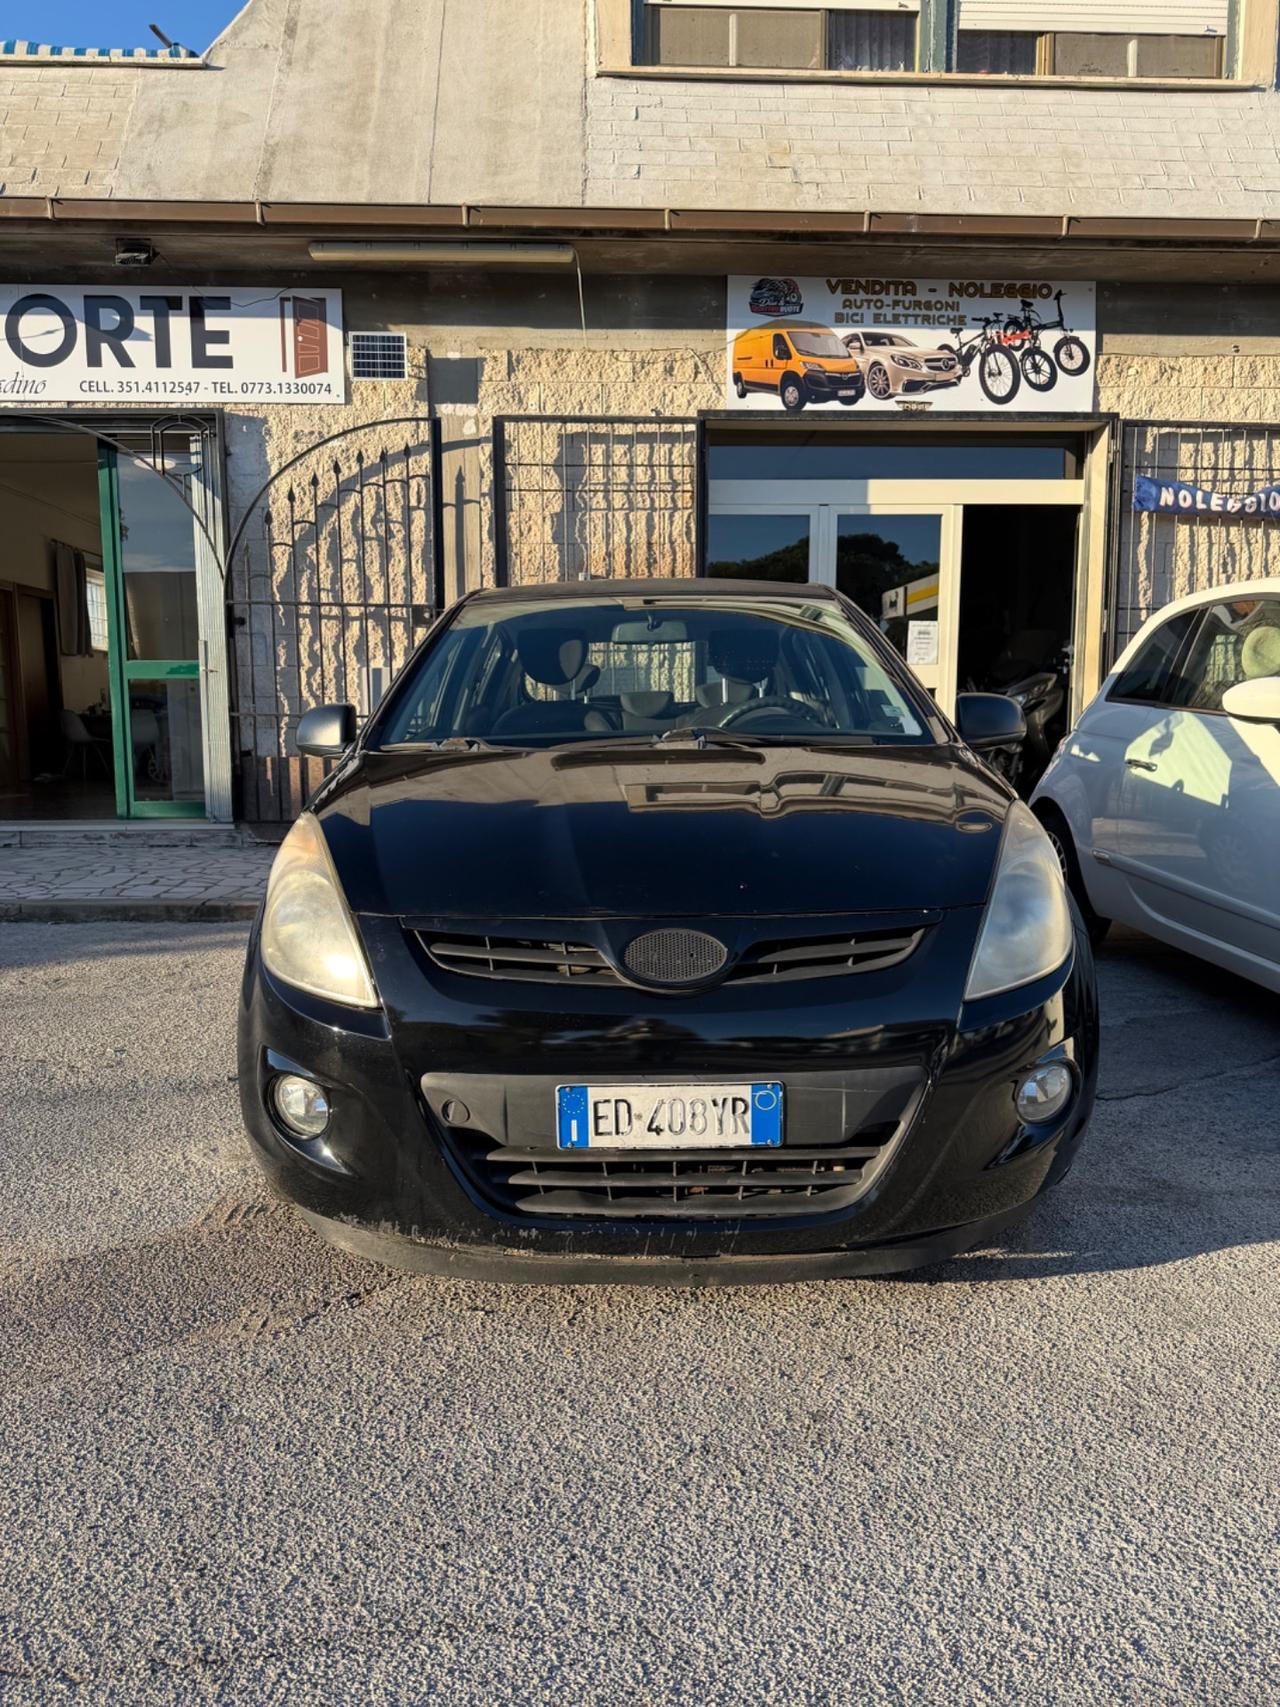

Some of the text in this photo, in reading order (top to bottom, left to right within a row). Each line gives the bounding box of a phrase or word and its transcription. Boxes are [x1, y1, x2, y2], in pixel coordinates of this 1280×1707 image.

[826, 279, 917, 296] VENDITA
[948, 282, 1053, 299] NOLEGGIO
[842, 298, 960, 312] AUTO-FURGONI
[834, 312, 967, 326] BICI ELETTRICHE
[5, 293, 234, 368] ORTE
[79, 380, 114, 393] CELL.
[117, 381, 200, 394] 351.4112547
[211, 382, 238, 394] TEL.
[241, 382, 332, 395] 0773.1330074
[592, 1097, 750, 1136] ED 408YR
